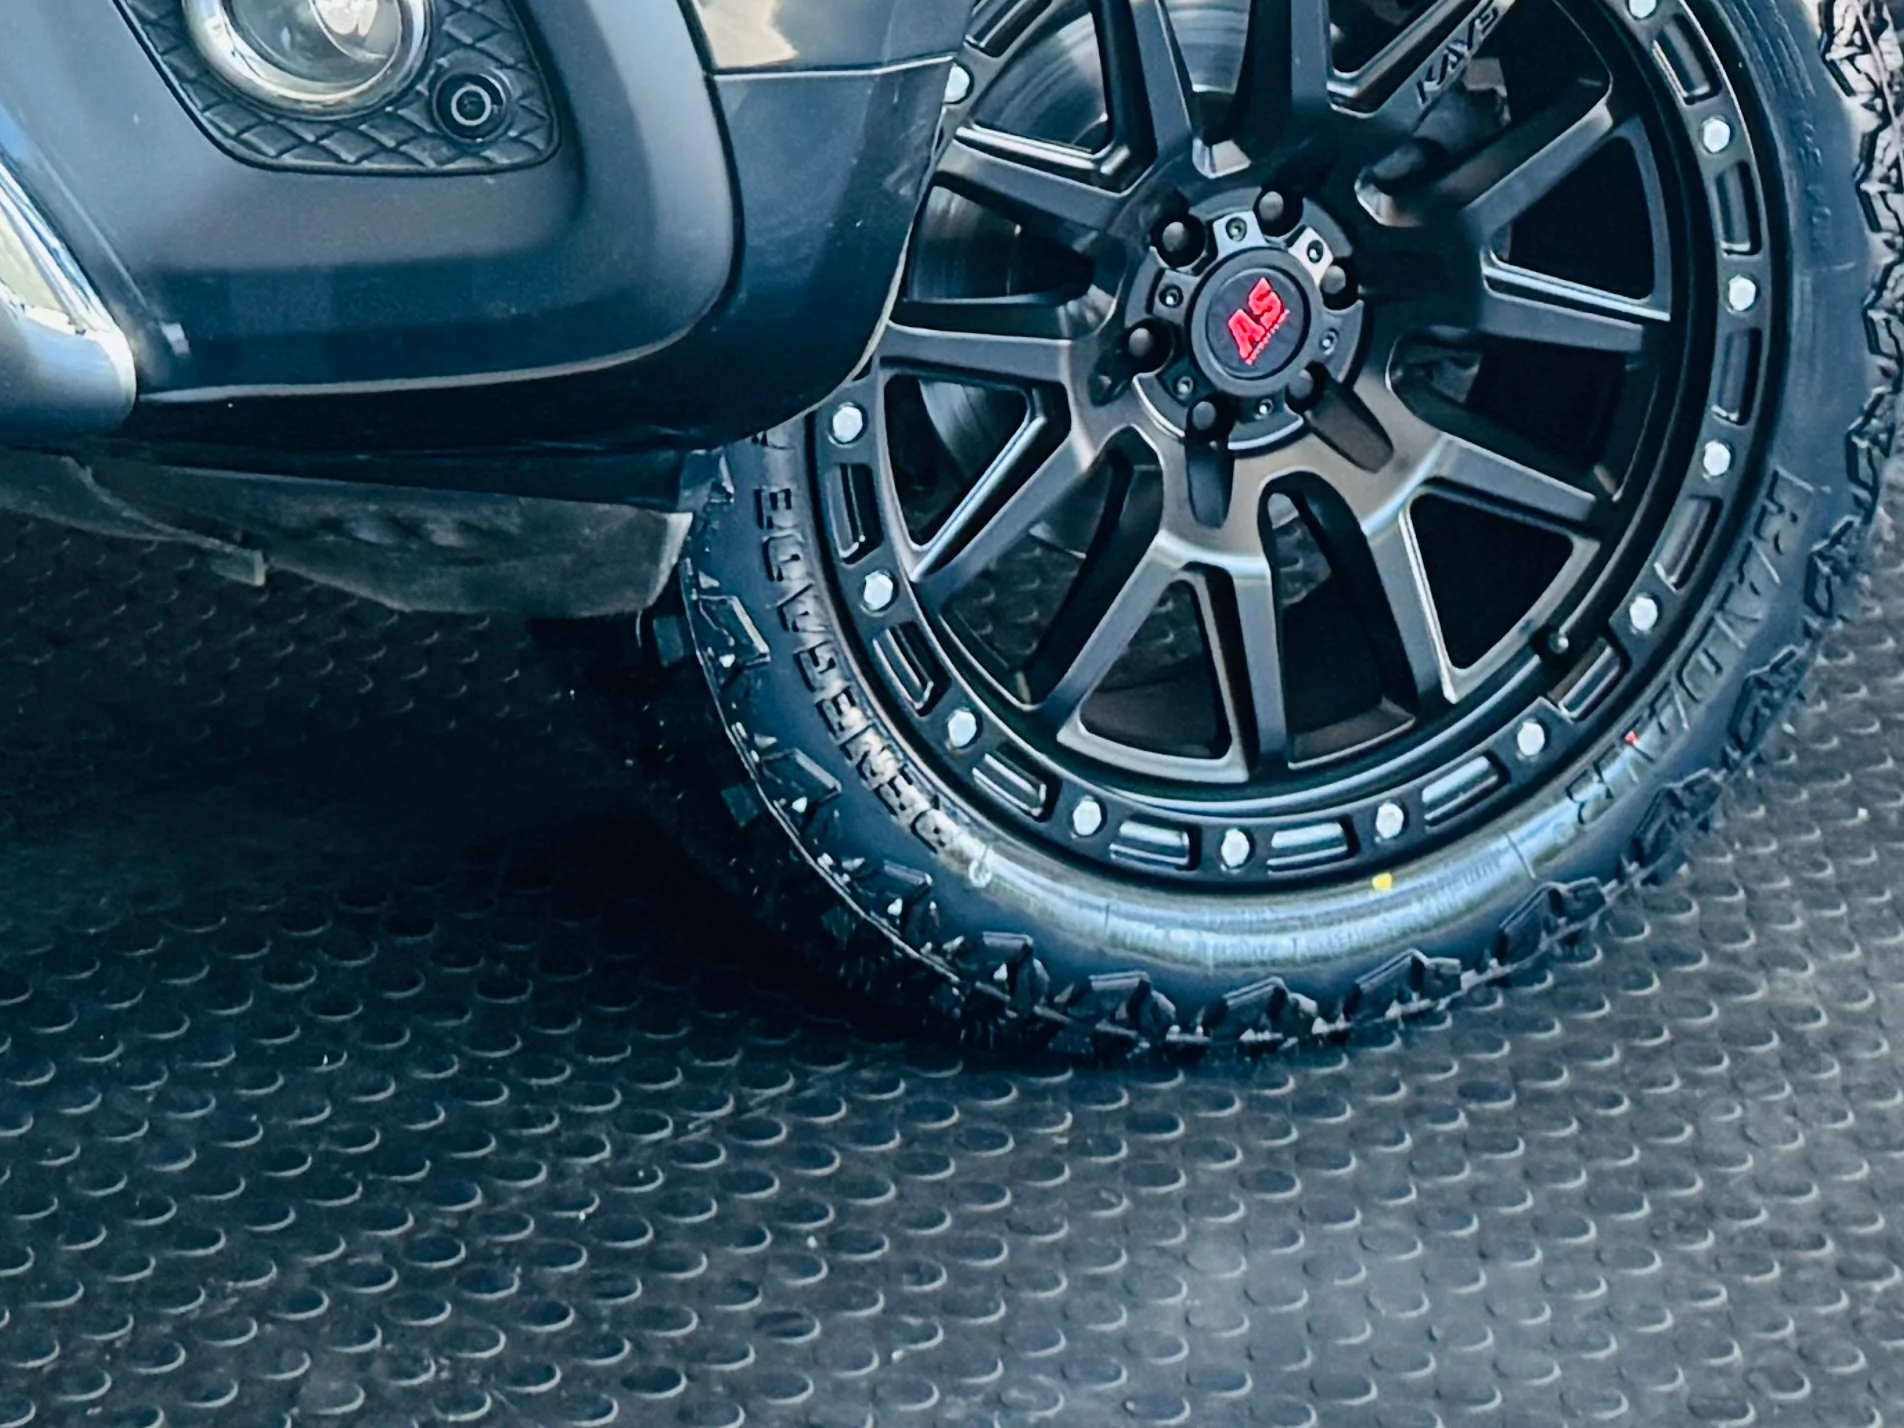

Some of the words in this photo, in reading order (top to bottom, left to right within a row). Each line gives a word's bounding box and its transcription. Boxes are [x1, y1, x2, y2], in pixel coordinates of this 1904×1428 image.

[1227, 276, 1283, 361] AS
[752, 486, 946, 854] RENEGADE
[1565, 464, 1815, 826] RADAR
